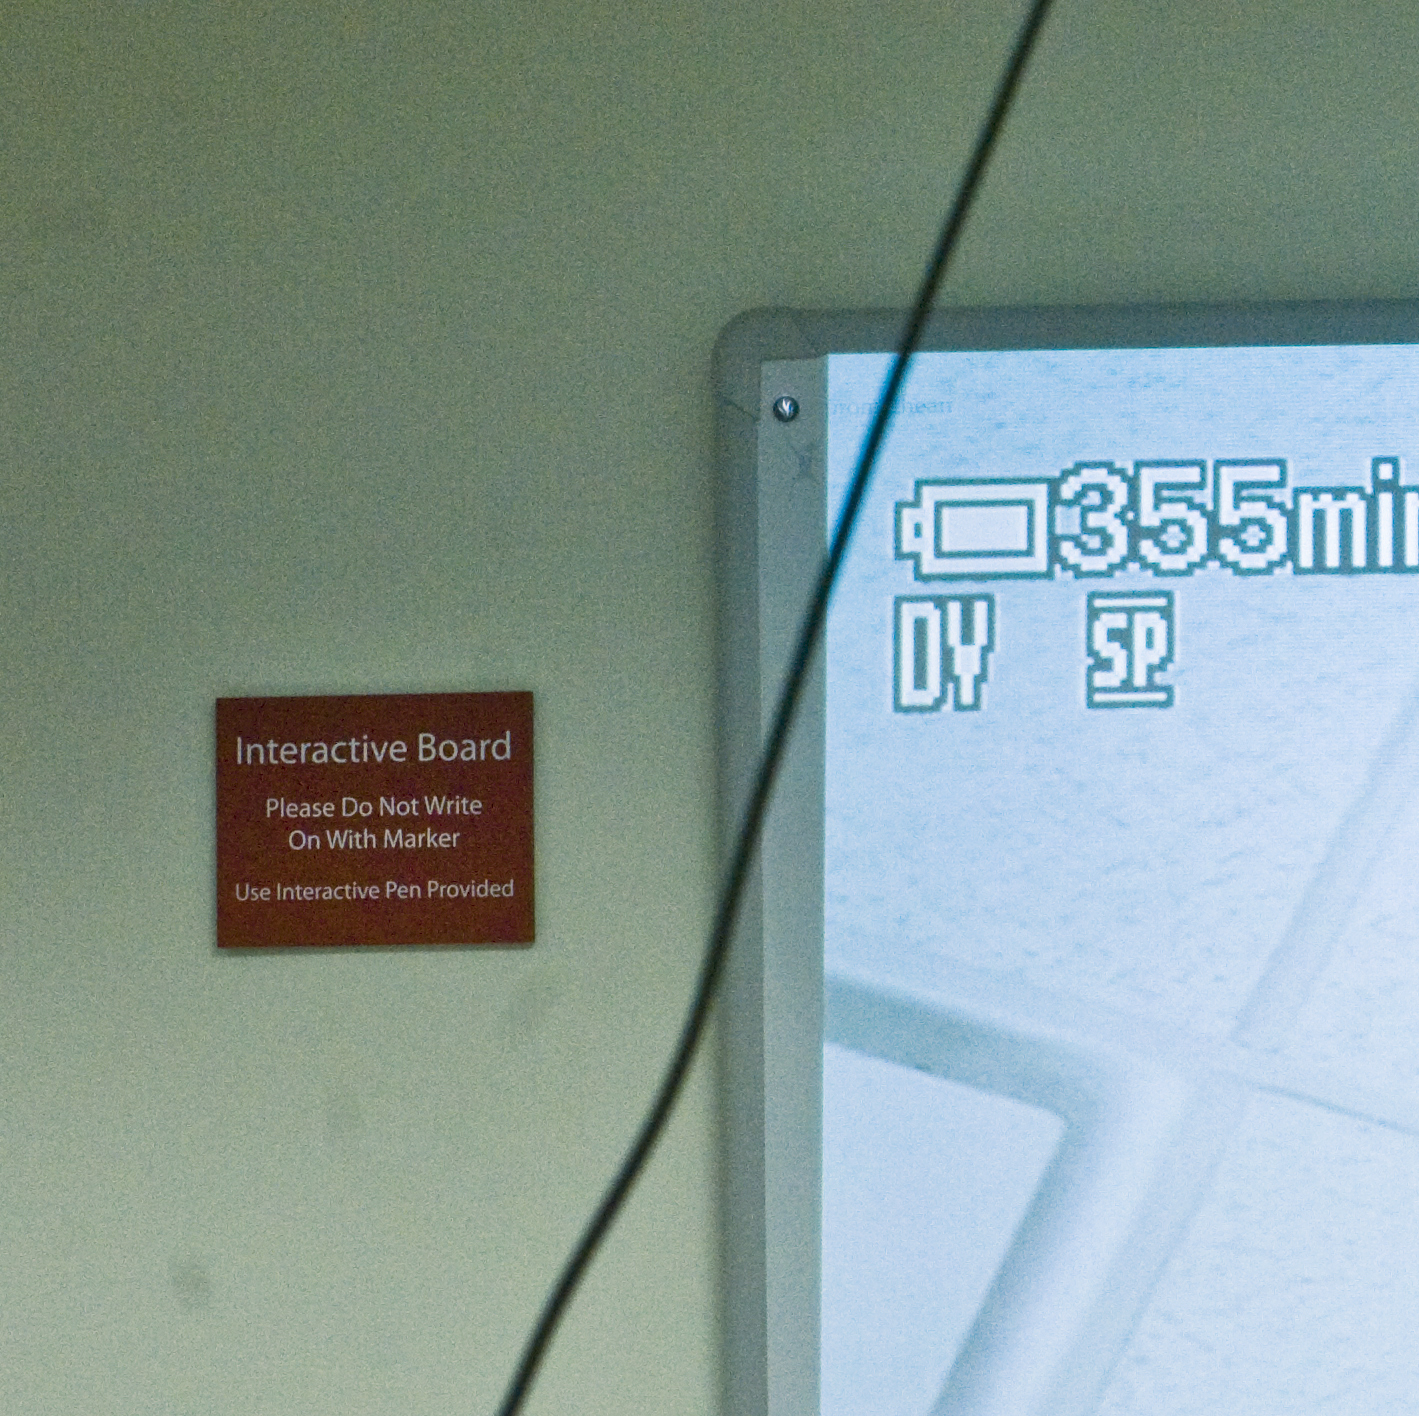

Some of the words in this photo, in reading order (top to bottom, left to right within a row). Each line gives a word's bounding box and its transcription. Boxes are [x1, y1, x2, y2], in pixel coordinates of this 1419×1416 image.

[893, 594, 995, 712] DV
[1087, 602, 1173, 696] SP
[236, 734, 408, 765] Interactive
[417, 730, 512, 763] Board
[265, 797, 335, 818] Please
[341, 797, 373, 817] Do
[379, 796, 419, 817] Not
[424, 795, 483, 816] Write
[288, 829, 321, 850] On
[326, 828, 377, 849] With
[383, 828, 461, 849] Marker
[234, 883, 271, 901] Use
[276, 881, 380, 901] Interactive
[385, 881, 422, 899] Pen
[426, 879, 515, 899] Provided
